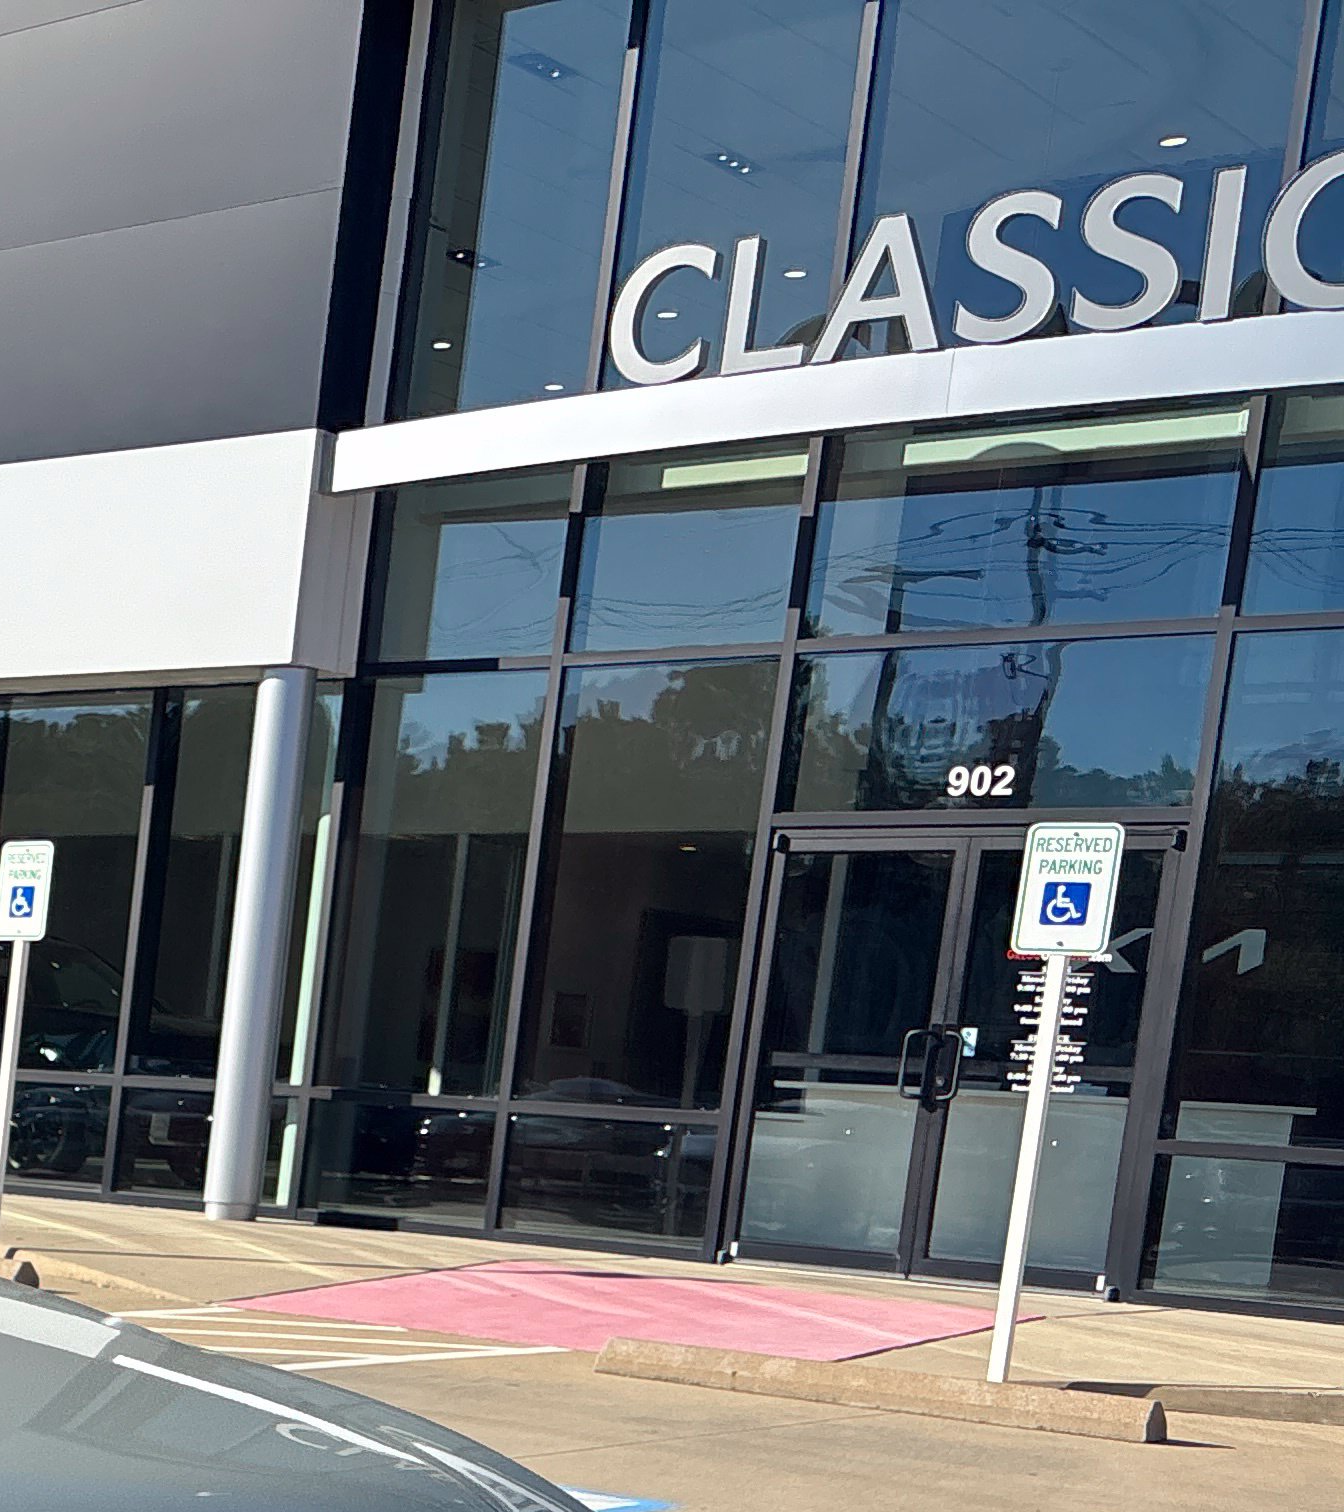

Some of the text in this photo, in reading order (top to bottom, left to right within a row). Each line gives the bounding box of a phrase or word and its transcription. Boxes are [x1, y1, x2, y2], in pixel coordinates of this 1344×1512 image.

[947, 765, 1015, 797] 902
[1035, 836, 1113, 853] RESERVED
[1038, 858, 1103, 875] PARKING
